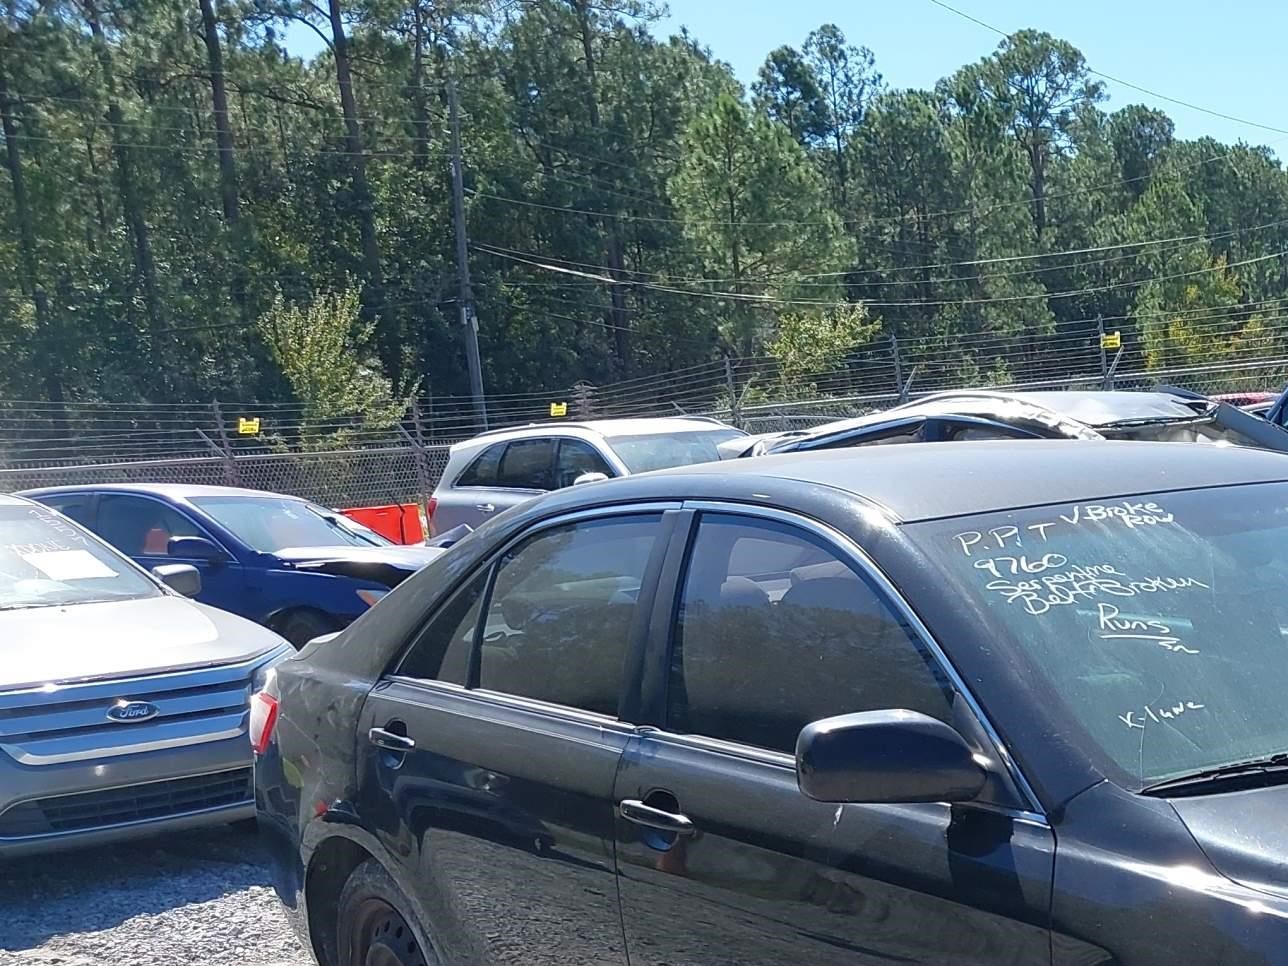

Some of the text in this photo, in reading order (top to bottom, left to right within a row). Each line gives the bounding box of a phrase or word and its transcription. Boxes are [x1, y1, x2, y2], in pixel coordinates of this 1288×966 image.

[973, 553, 1068, 578] 9760
[1097, 602, 1171, 634] Runs
[120, 703, 149, 718] Ford
